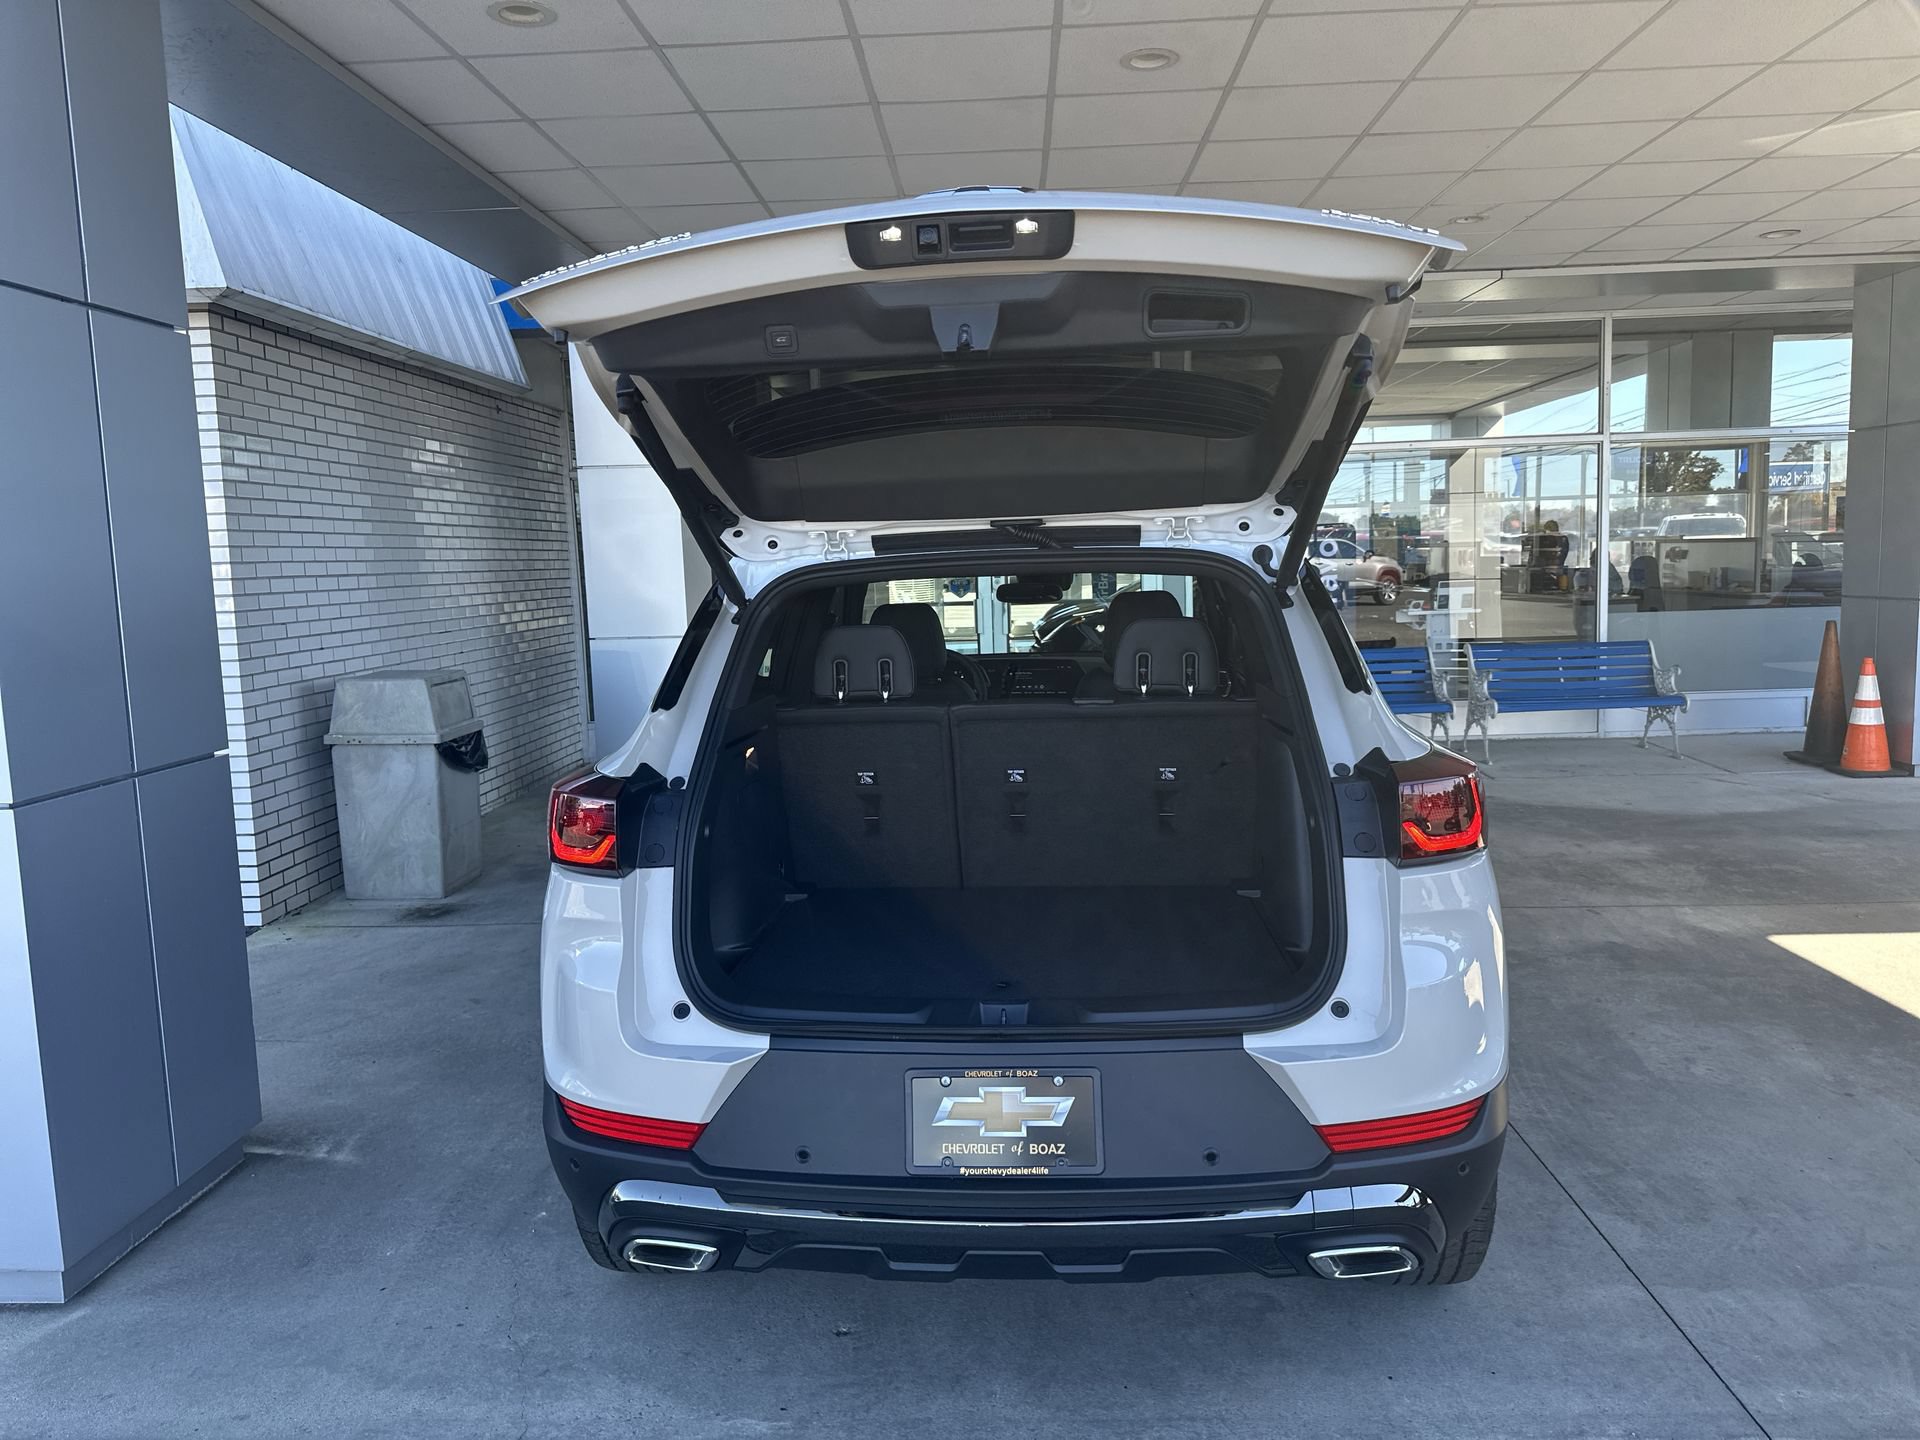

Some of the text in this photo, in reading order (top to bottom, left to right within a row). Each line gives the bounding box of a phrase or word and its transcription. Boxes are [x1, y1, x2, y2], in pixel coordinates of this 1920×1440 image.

[964, 1070, 1003, 1078] CHEVROLET
[1005, 1069, 1013, 1078] of
[942, 1141, 1066, 1156] CHEVROLET of BOAZ
[959, 1166, 1049, 1176] #yourchevydealer4life
